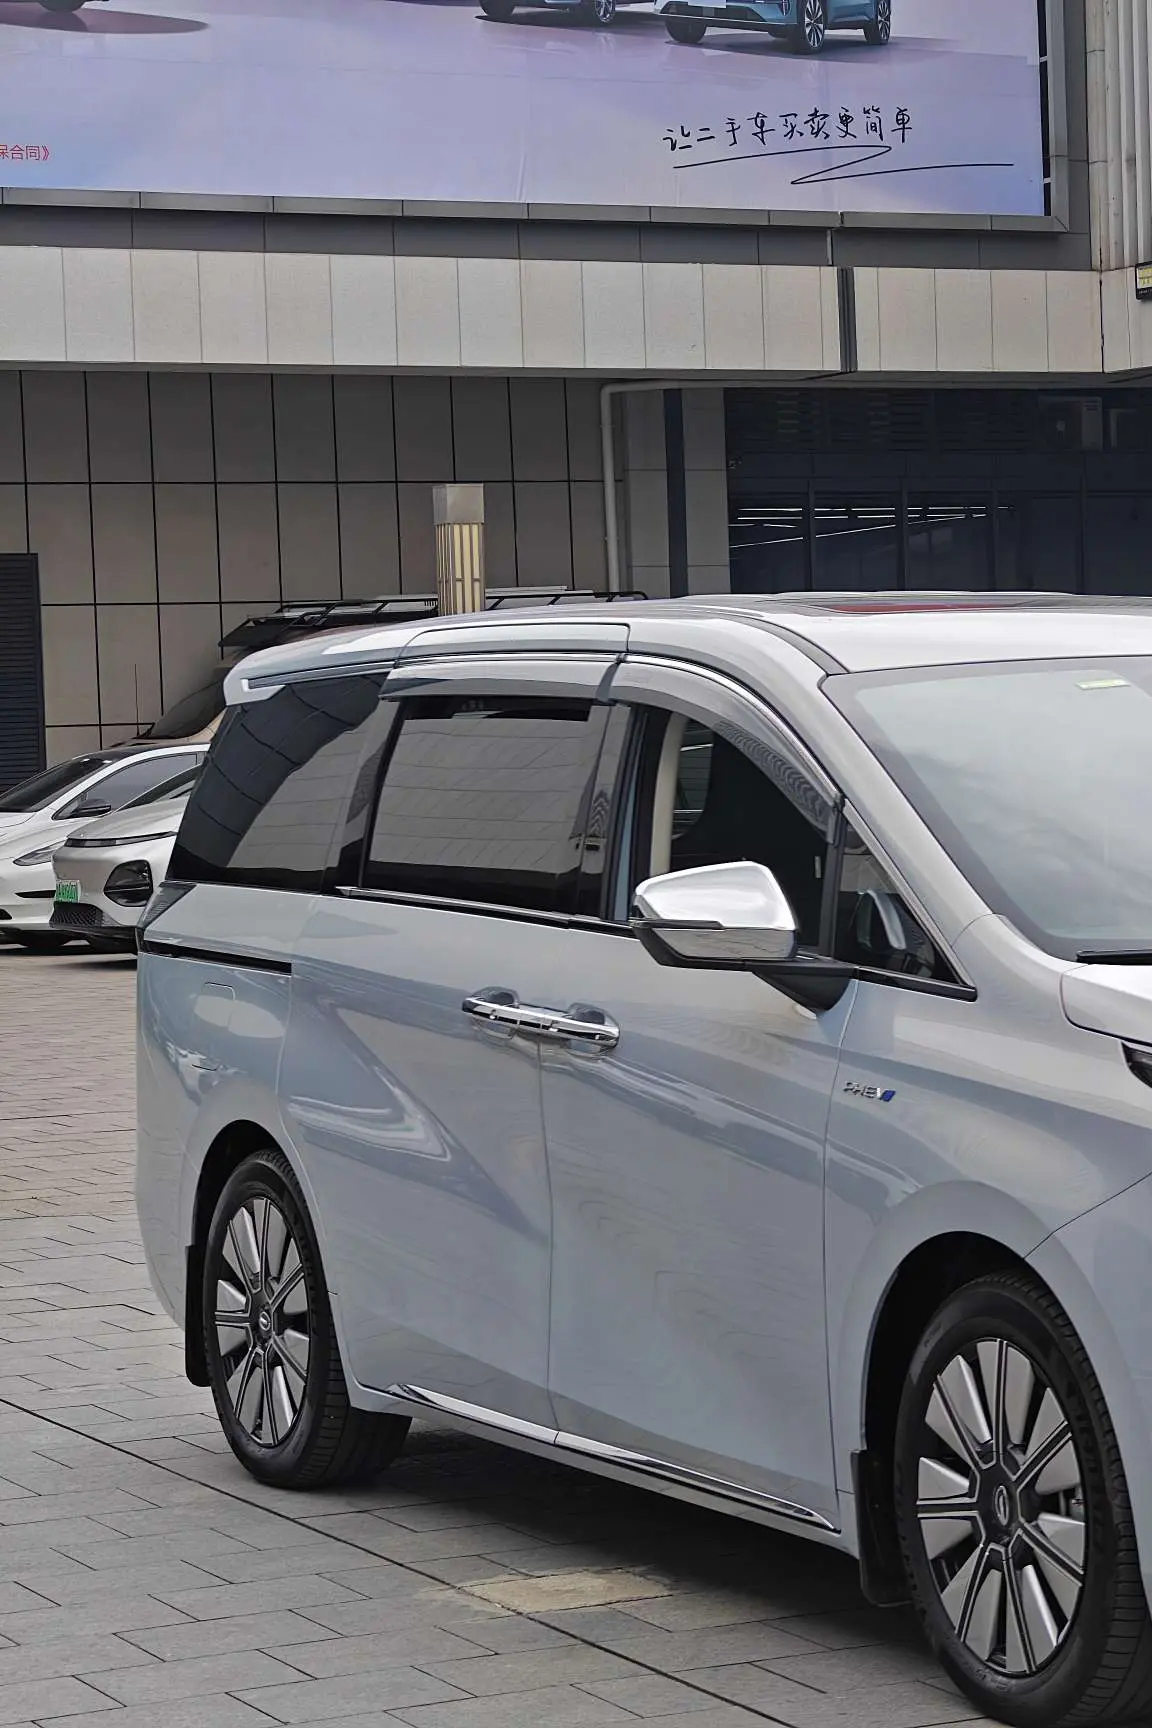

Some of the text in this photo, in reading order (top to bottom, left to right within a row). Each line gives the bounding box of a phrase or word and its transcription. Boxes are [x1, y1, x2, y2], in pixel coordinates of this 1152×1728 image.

[662, 105, 914, 151] 让二手车买卖更简单
